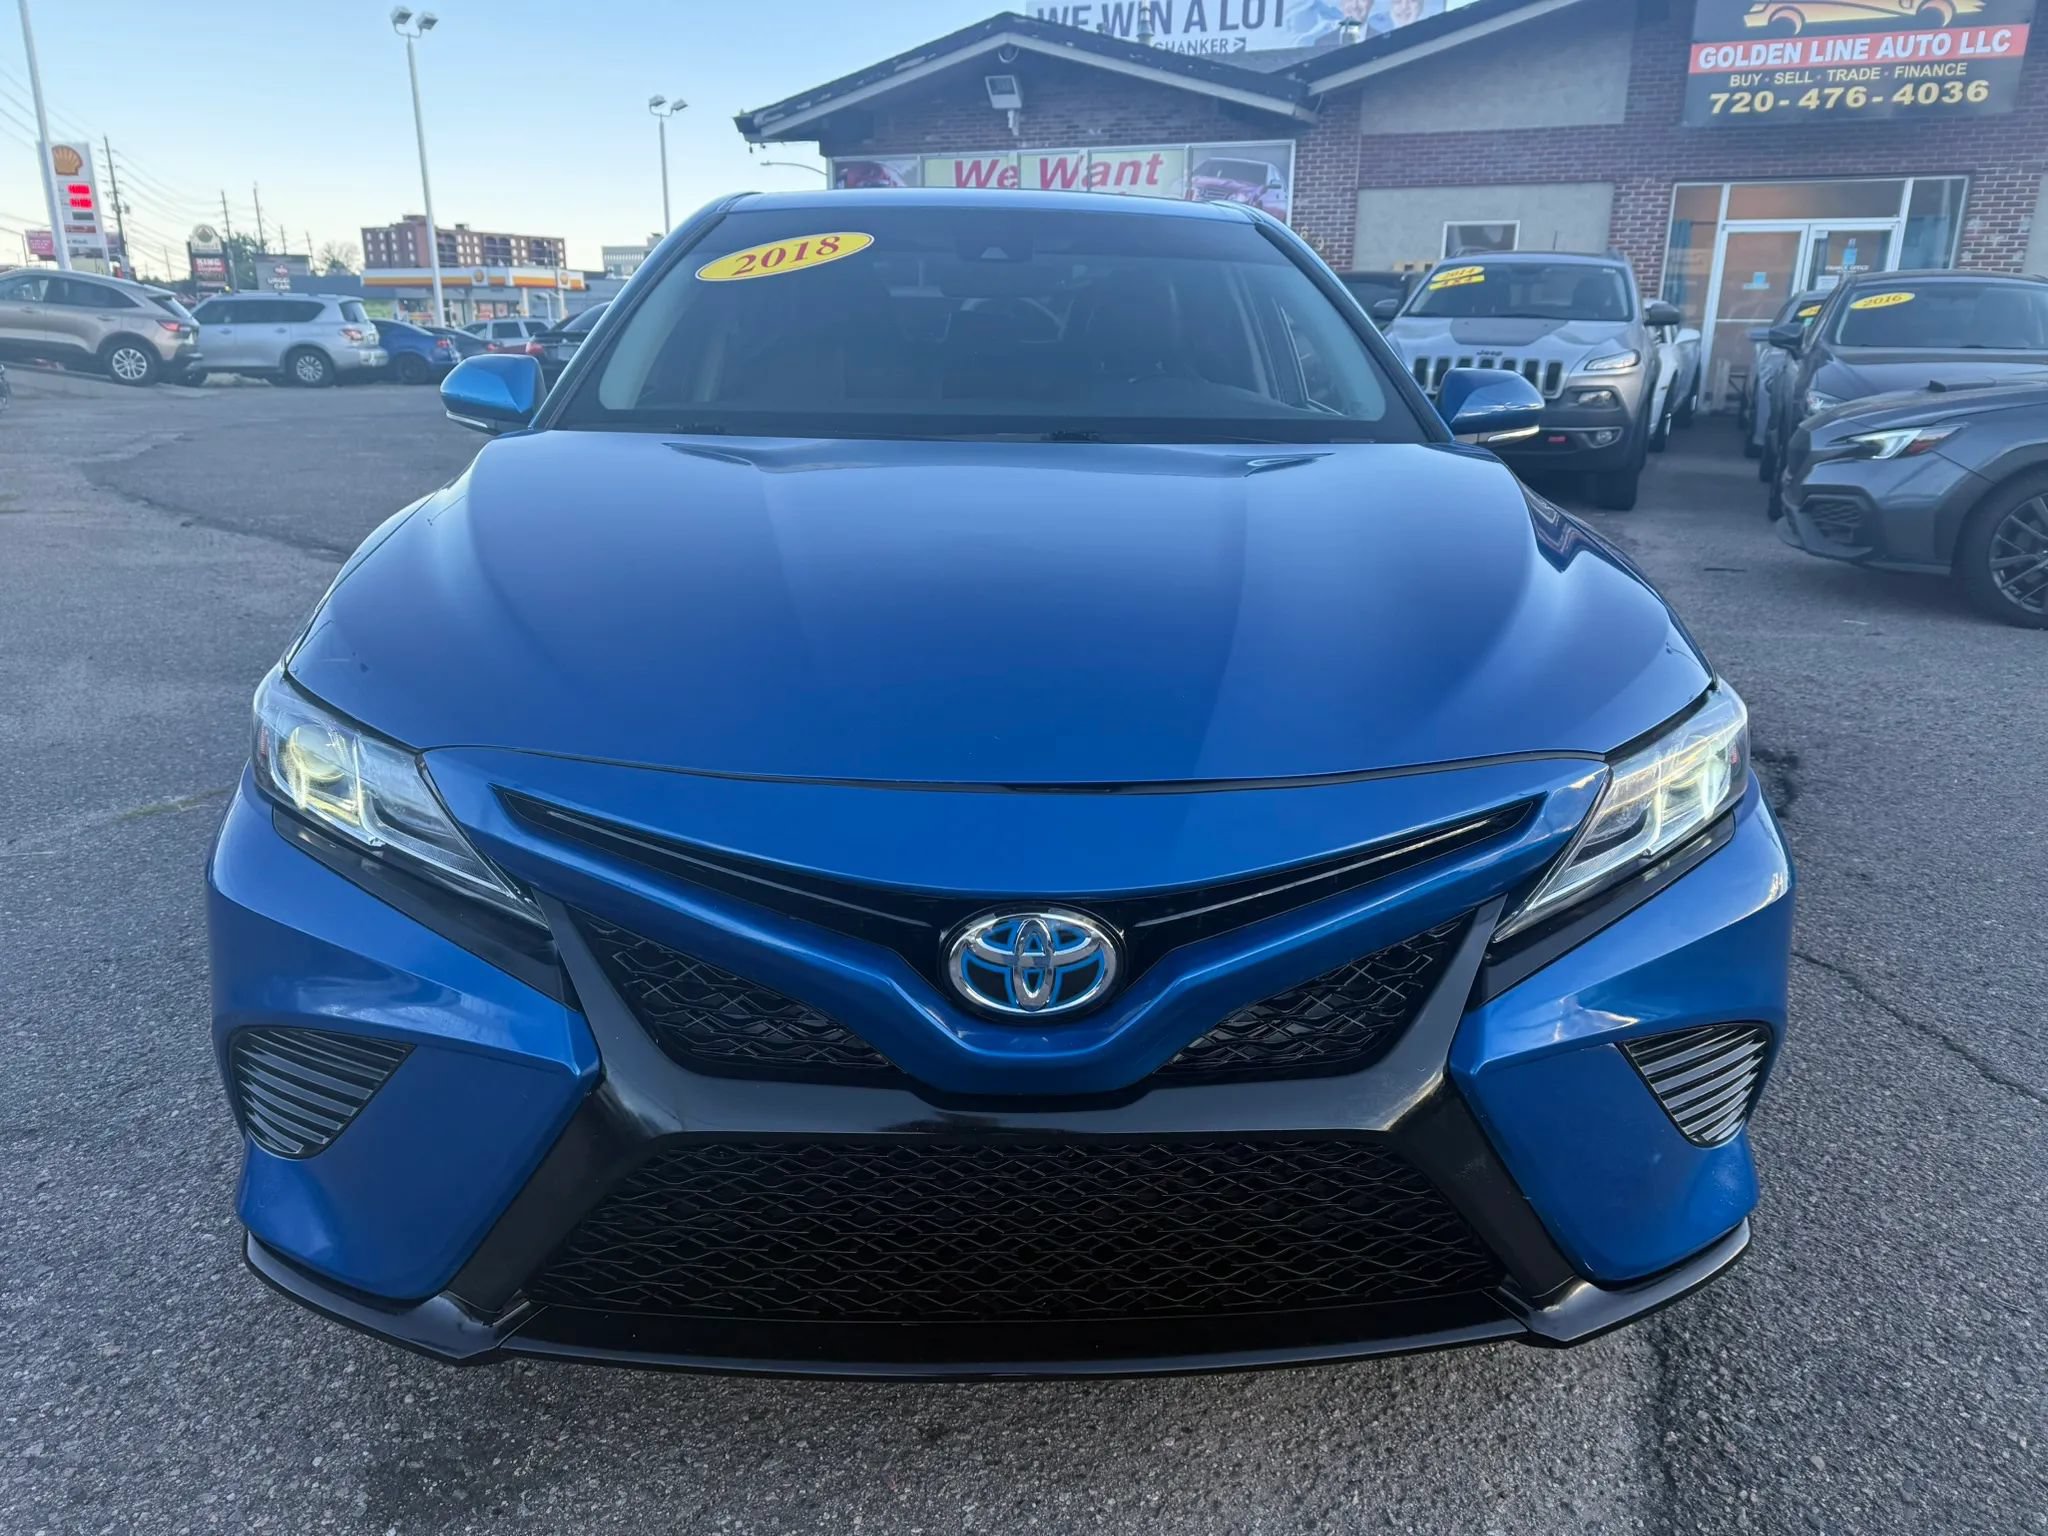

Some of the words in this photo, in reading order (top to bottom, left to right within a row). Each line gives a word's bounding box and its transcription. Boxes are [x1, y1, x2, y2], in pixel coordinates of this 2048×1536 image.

[1182, 0, 1208, 34] A
[1699, 41, 1802, 69] GOLDEN
[1809, 37, 1871, 63] LINE
[1875, 32, 1951, 60] AUTO
[1959, 29, 2011, 55] LLC
[1729, 73, 1762, 87] BUY
[1774, 70, 1814, 85] SELL
[1827, 67, 1881, 82] TRADE
[1894, 62, 1968, 79] FINANCE
[953, 159, 1019, 189] We
[1039, 153, 1164, 191] Want
[731, 235, 841, 277] 2018
[1862, 293, 1904, 307] 2016
